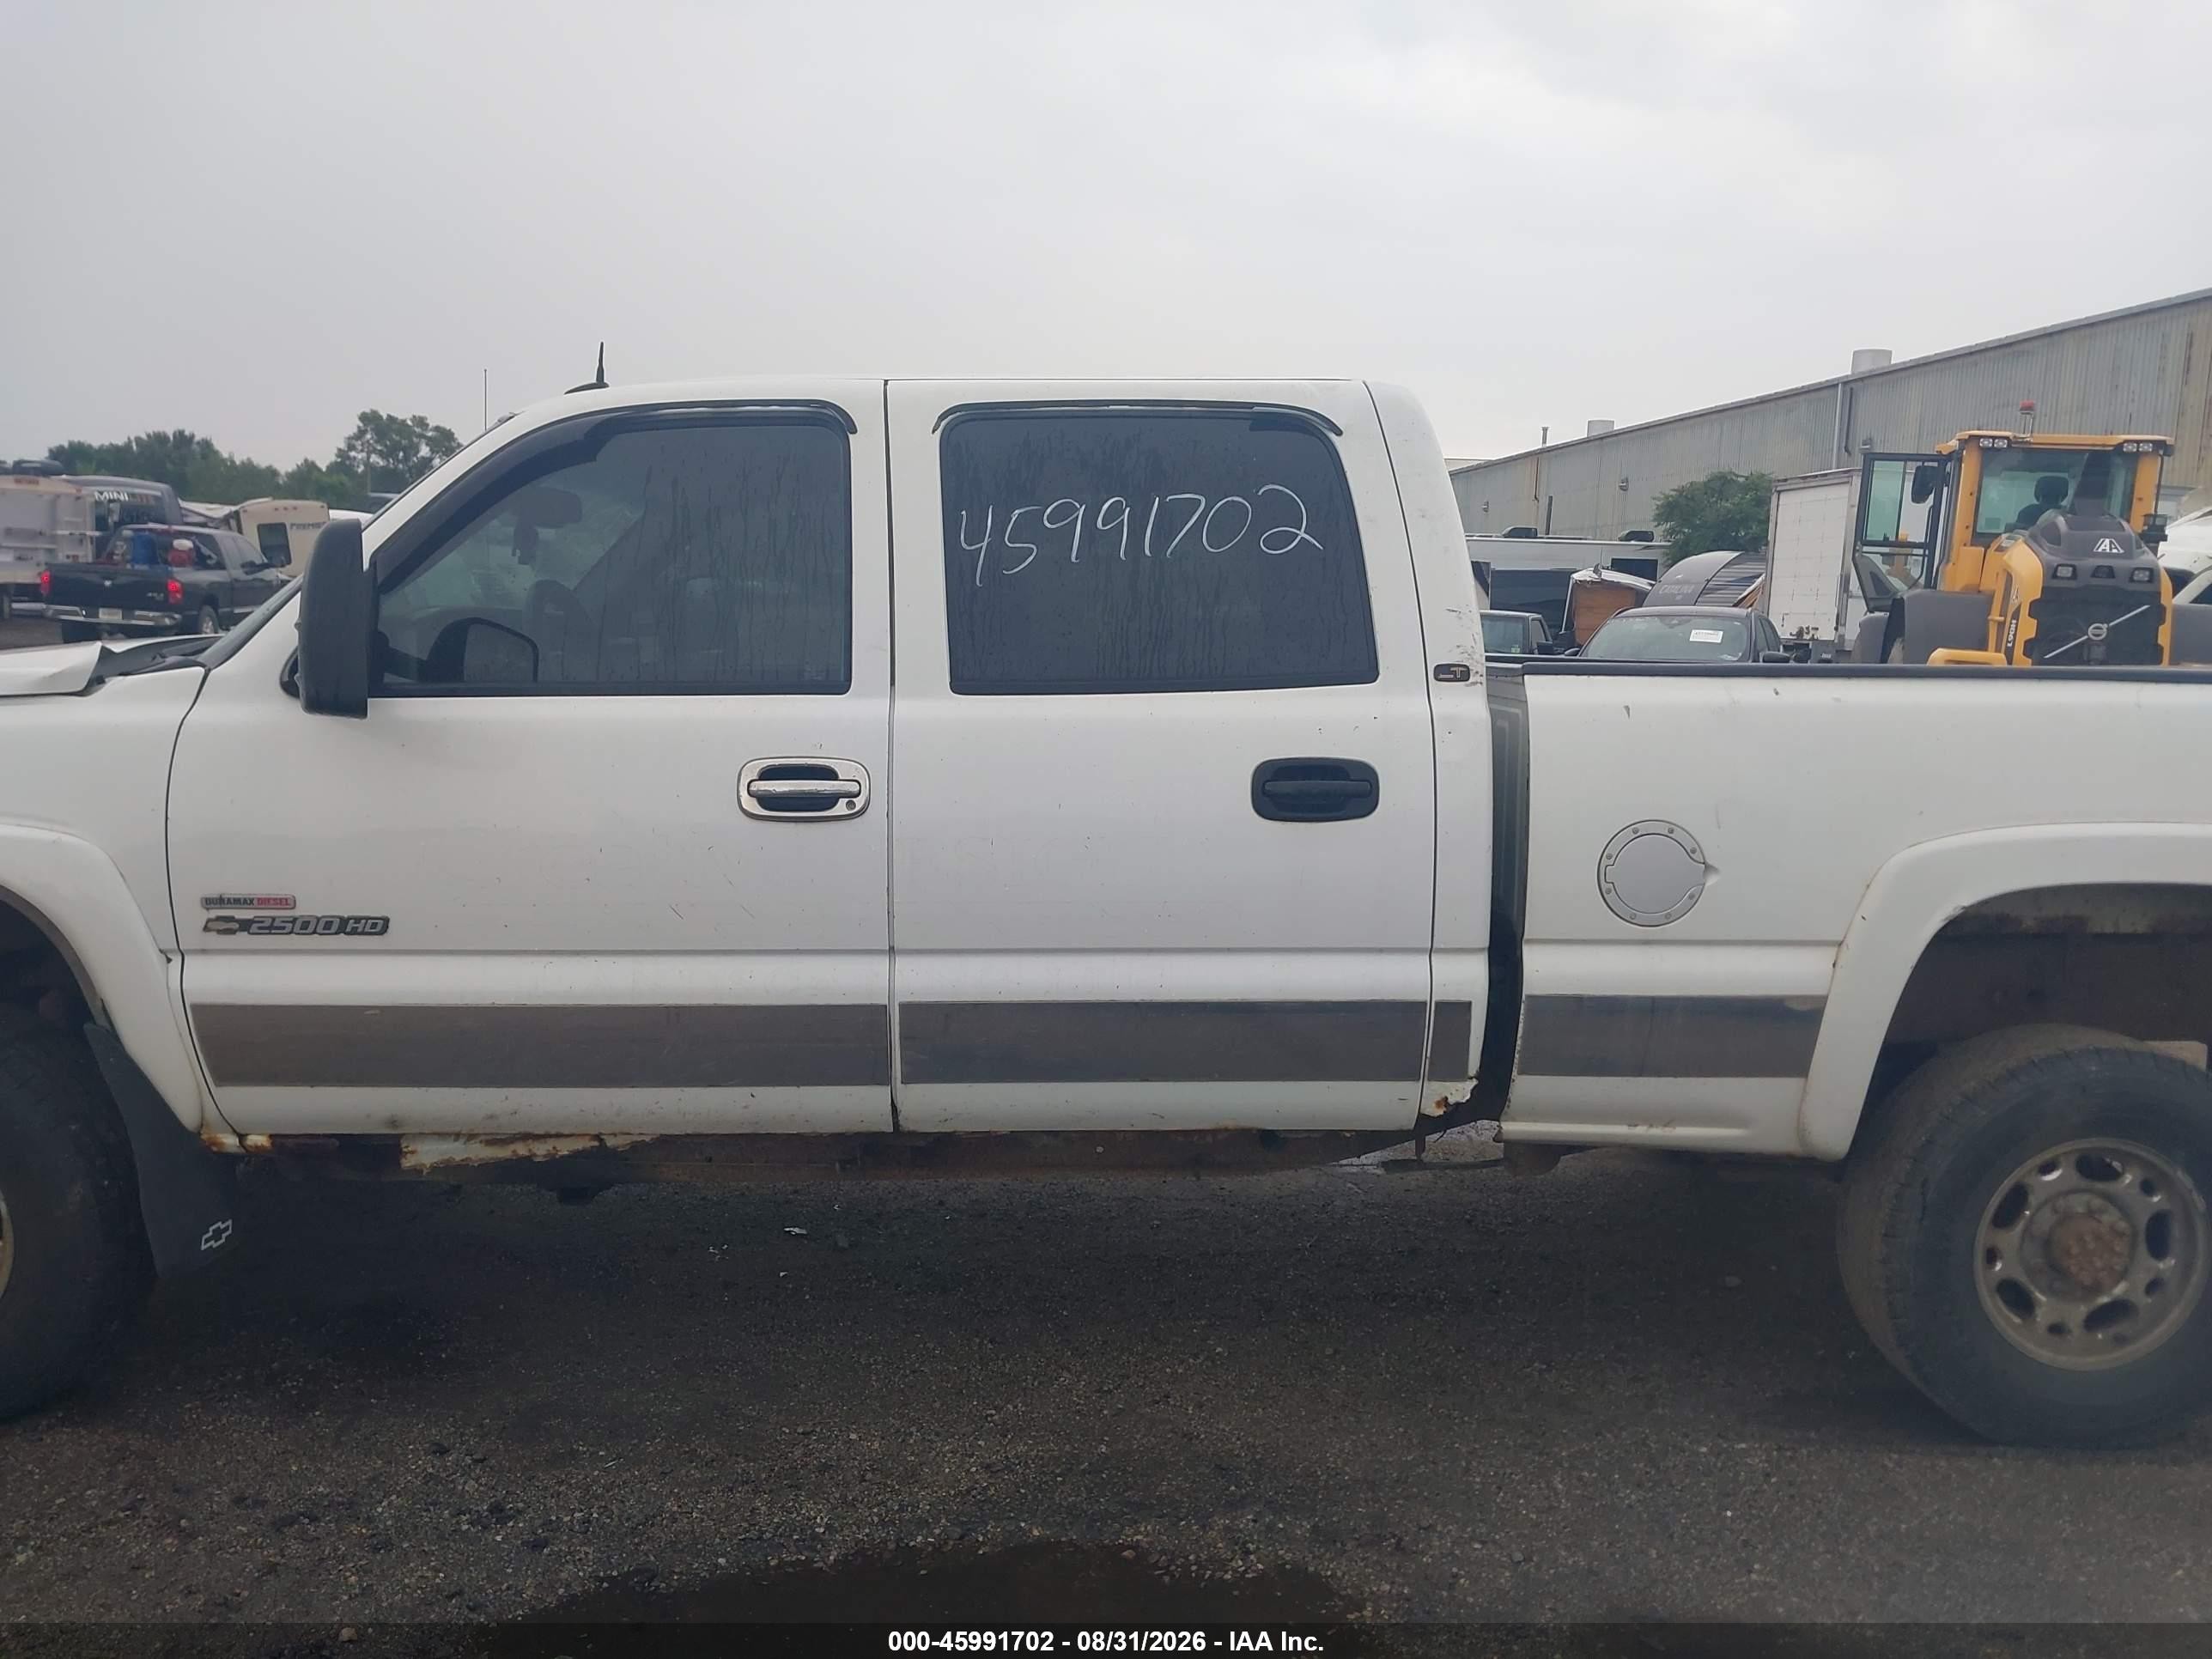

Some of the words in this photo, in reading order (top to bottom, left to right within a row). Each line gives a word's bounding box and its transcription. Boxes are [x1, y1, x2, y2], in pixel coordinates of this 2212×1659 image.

[94, 489, 129, 501] MINI
[960, 484, 1324, 586] 45991702
[2007, 619, 2017, 647] L90H
[204, 896, 254, 907] DURAMAX
[257, 897, 290, 907] DIESEL
[249, 916, 340, 934] 2500
[345, 919, 384, 933] HD
